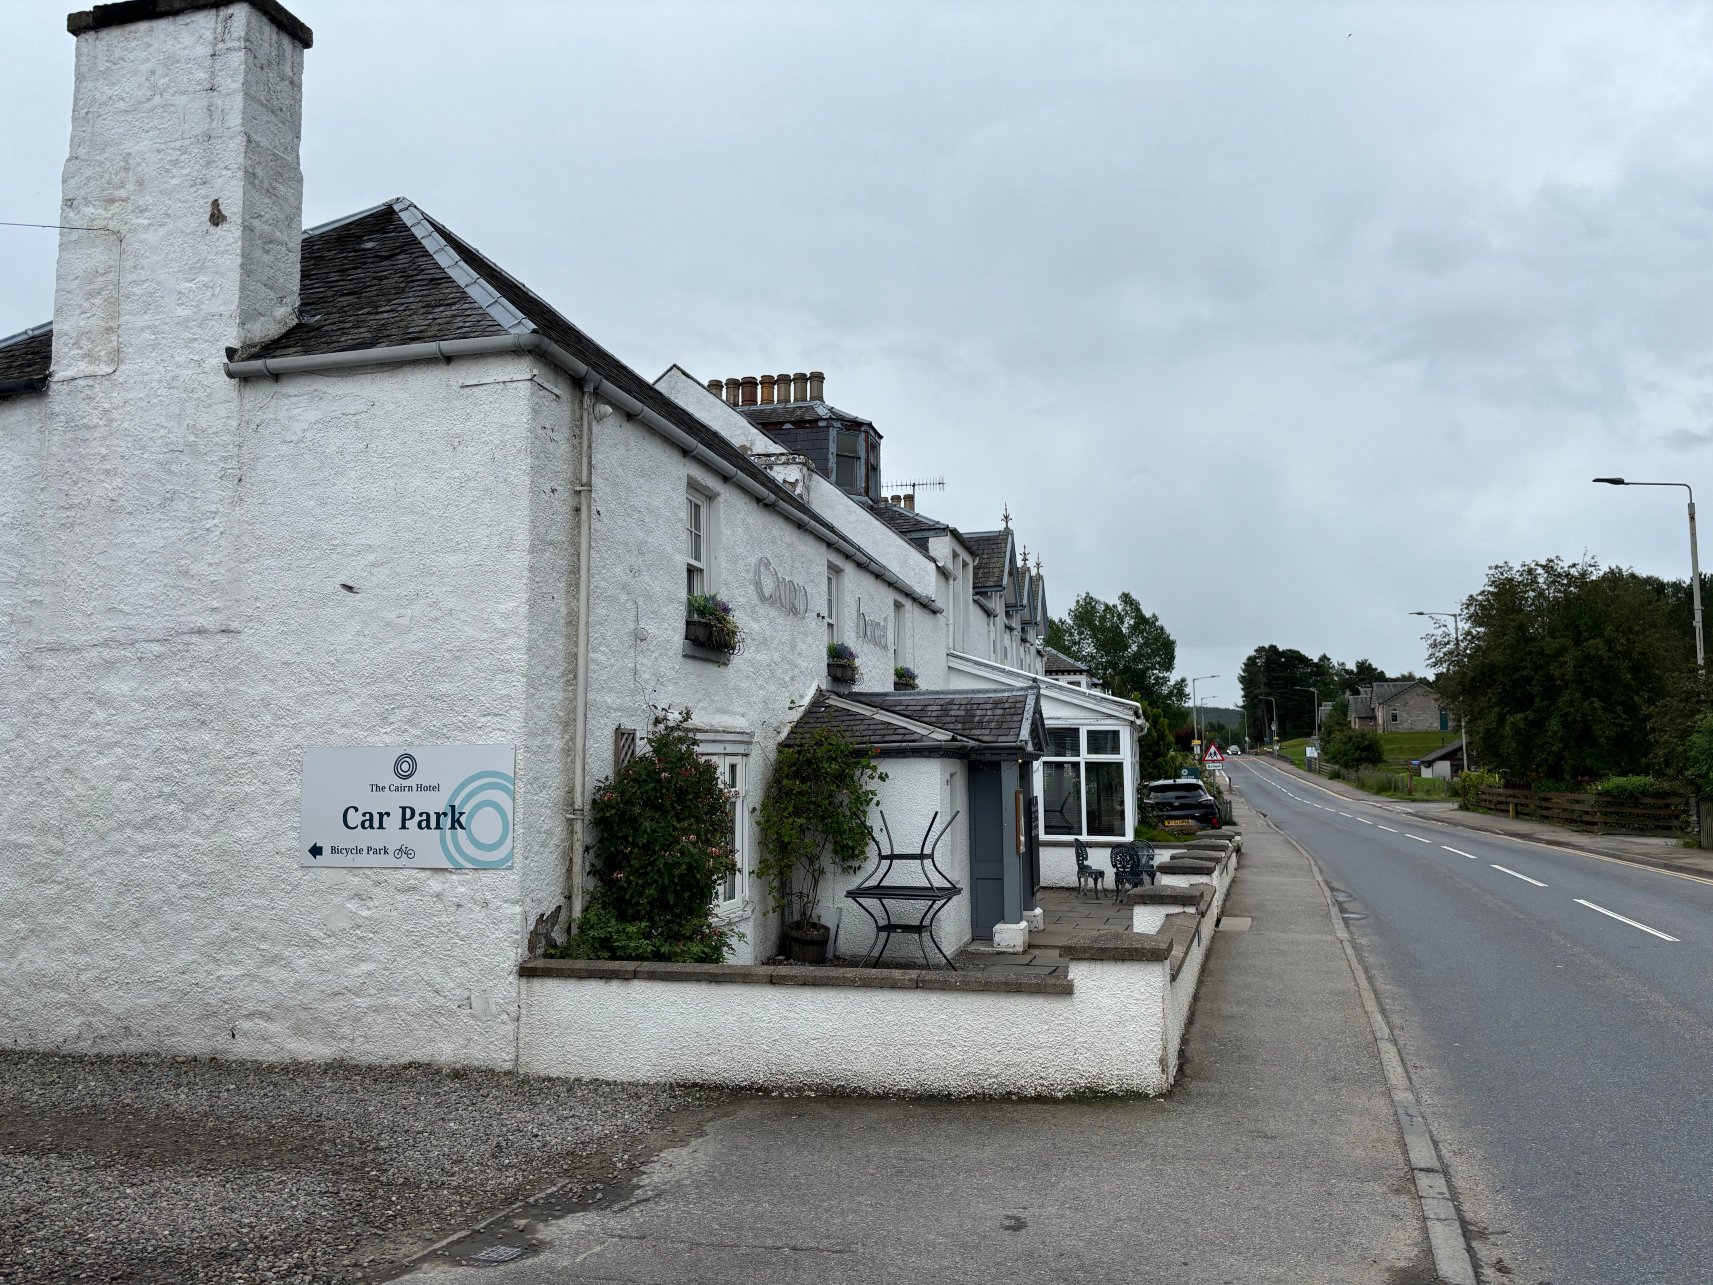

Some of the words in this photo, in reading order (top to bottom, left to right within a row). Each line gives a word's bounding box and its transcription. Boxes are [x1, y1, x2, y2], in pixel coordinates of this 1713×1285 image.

[369, 783, 387, 793] The
[388, 783, 414, 793] Cairn
[415, 783, 441, 793] Hotel
[342, 805, 391, 831] Car
[398, 804, 467, 831] Park
[330, 845, 364, 858] Bicycle
[366, 845, 390, 856] Park
